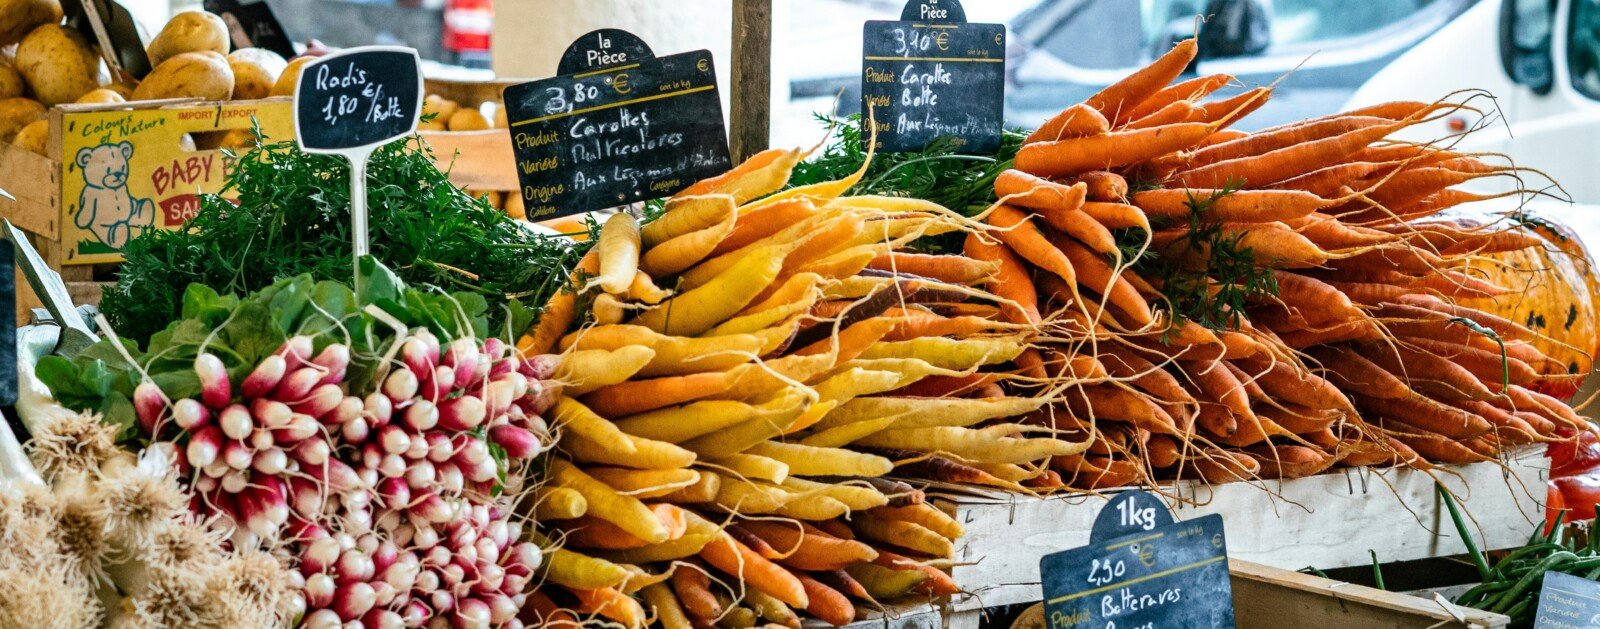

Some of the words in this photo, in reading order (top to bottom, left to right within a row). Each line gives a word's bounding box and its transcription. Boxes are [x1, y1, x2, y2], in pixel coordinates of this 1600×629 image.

[920, 4, 947, 19] Pièce
[598, 32, 611, 49] la
[894, 28, 930, 58] 3,10
[936, 32, 949, 51] €
[586, 50, 627, 67] Pièce
[697, 58, 709, 72] €
[316, 61, 366, 90] Radis
[865, 66, 895, 83] Produit
[900, 63, 951, 85] Carottes
[544, 83, 599, 114] 3,80
[611, 73, 631, 94] €
[901, 85, 938, 107] Botte
[178, 110, 214, 121] IMPORT
[221, 108, 258, 120] EXPORT
[322, 95, 358, 125] 1,80
[82, 114, 133, 137] Colours
[100, 130, 112, 144] of
[119, 117, 165, 138] Nature
[515, 130, 560, 150] Produit
[570, 107, 650, 139] Carottes
[896, 112, 922, 135] Aux
[151, 154, 213, 196] BABY
[524, 183, 564, 203] Origine
[574, 170, 606, 190] Aux
[1116, 496, 1156, 531] 1kg
[1087, 559, 1126, 586] 2,90
[1545, 592, 1587, 609] Produit
[1051, 608, 1091, 629] Produit
